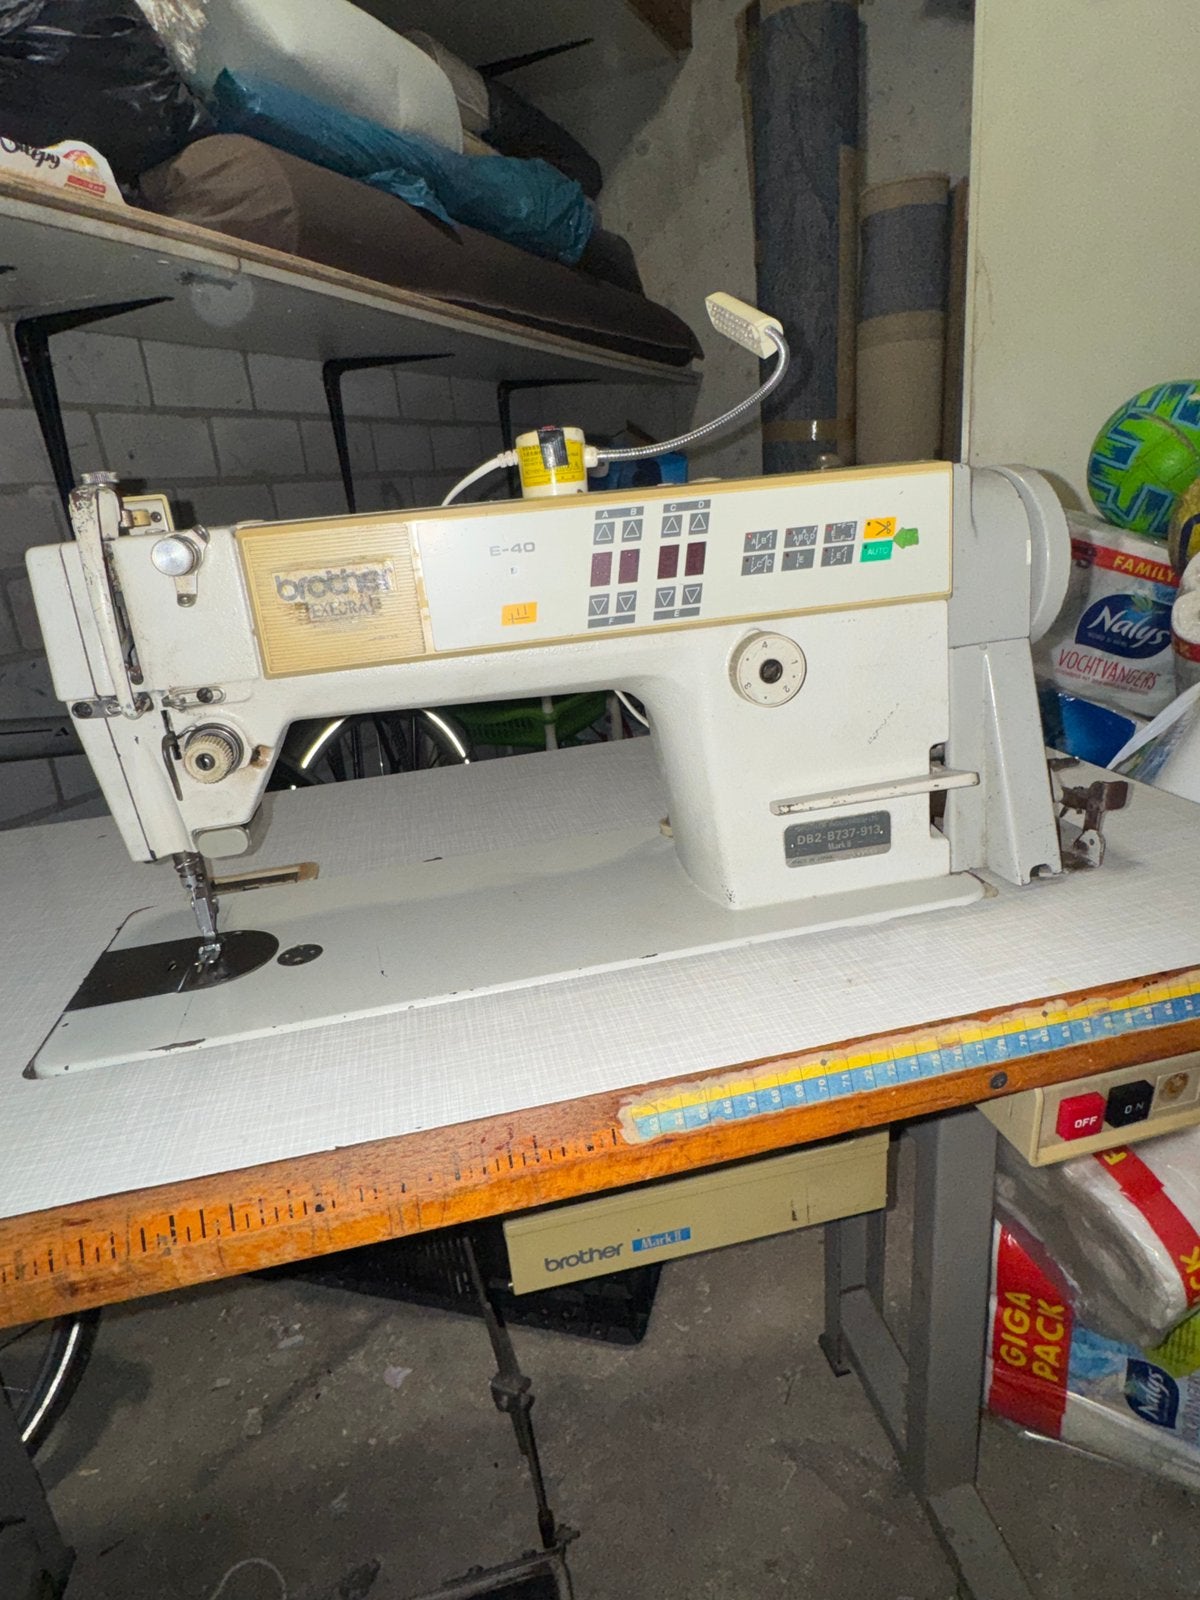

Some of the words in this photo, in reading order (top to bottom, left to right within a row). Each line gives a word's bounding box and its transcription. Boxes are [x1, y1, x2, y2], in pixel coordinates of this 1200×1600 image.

[698, 500, 705, 508] D
[601, 510, 609, 518] A
[630, 507, 637, 515] B
[489, 542, 535, 556] E-40
[867, 546, 889, 556] AUTO
[1113, 555, 1175, 582] FAMILY
[674, 609, 680, 617] E
[608, 617, 615, 625] F
[1087, 605, 1170, 648] Nalys
[1058, 648, 1159, 690] VOCHTVANGERS
[796, 824, 881, 845] DB2-B737-913
[1061, 1025, 1071, 1037] 81
[1082, 1020, 1092, 1033] 82
[1018, 1034, 1028, 1047] 79
[1040, 1029, 1050, 1042] 80
[975, 1044, 984, 1056] 77
[818, 1079, 828, 1092] 70
[841, 1074, 850, 1088] 71
[770, 1089, 780, 1103] 68
[794, 1084, 804, 1098] 69
[723, 1100, 733, 1114] 66
[747, 1095, 757, 1109] 67
[649, 1117, 659, 1131] 63
[1074, 1115, 1098, 1129] OFF
[640, 1231, 672, 1250] Mark
[544, 1243, 624, 1272] brother
[1000, 1292, 1031, 1367] GIGA
[1032, 1299, 1065, 1382] PACK
[1138, 1366, 1170, 1420] Nalys
